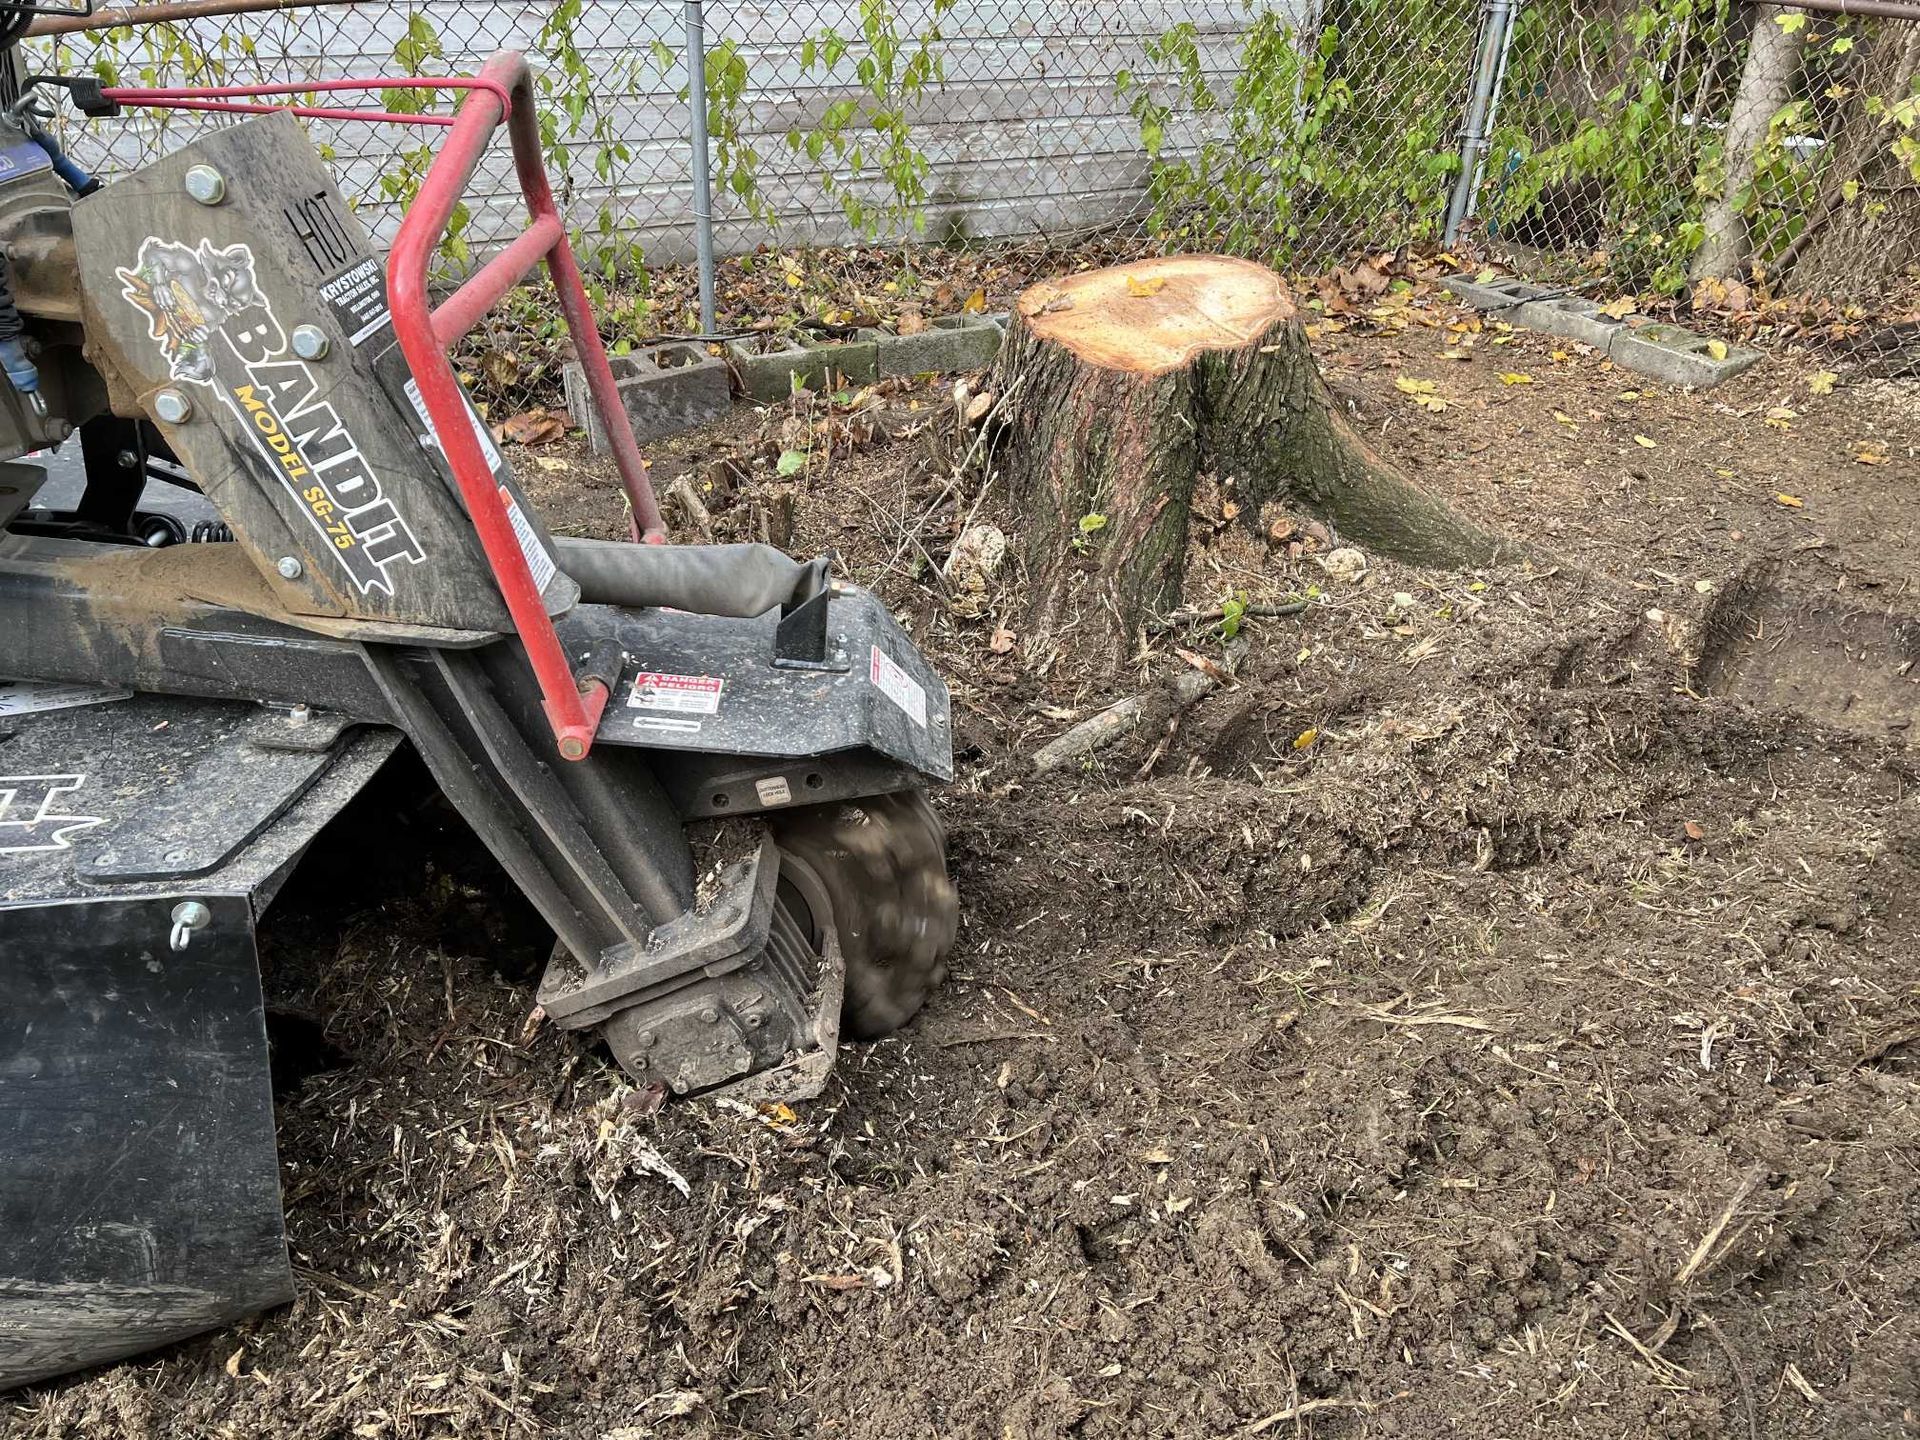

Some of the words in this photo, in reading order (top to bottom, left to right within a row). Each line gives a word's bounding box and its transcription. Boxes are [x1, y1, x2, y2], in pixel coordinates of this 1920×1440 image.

[283, 190, 358, 276] HOT
[319, 258, 379, 302] KRYSTOWSKI
[334, 287, 359, 307] TRACTOR
[219, 304, 427, 568] BANDIT
[234, 382, 312, 483] MODEL
[302, 485, 357, 550] SG-75
[658, 682, 717, 691] PELIGRO
[660, 674, 717, 685] DANGER
